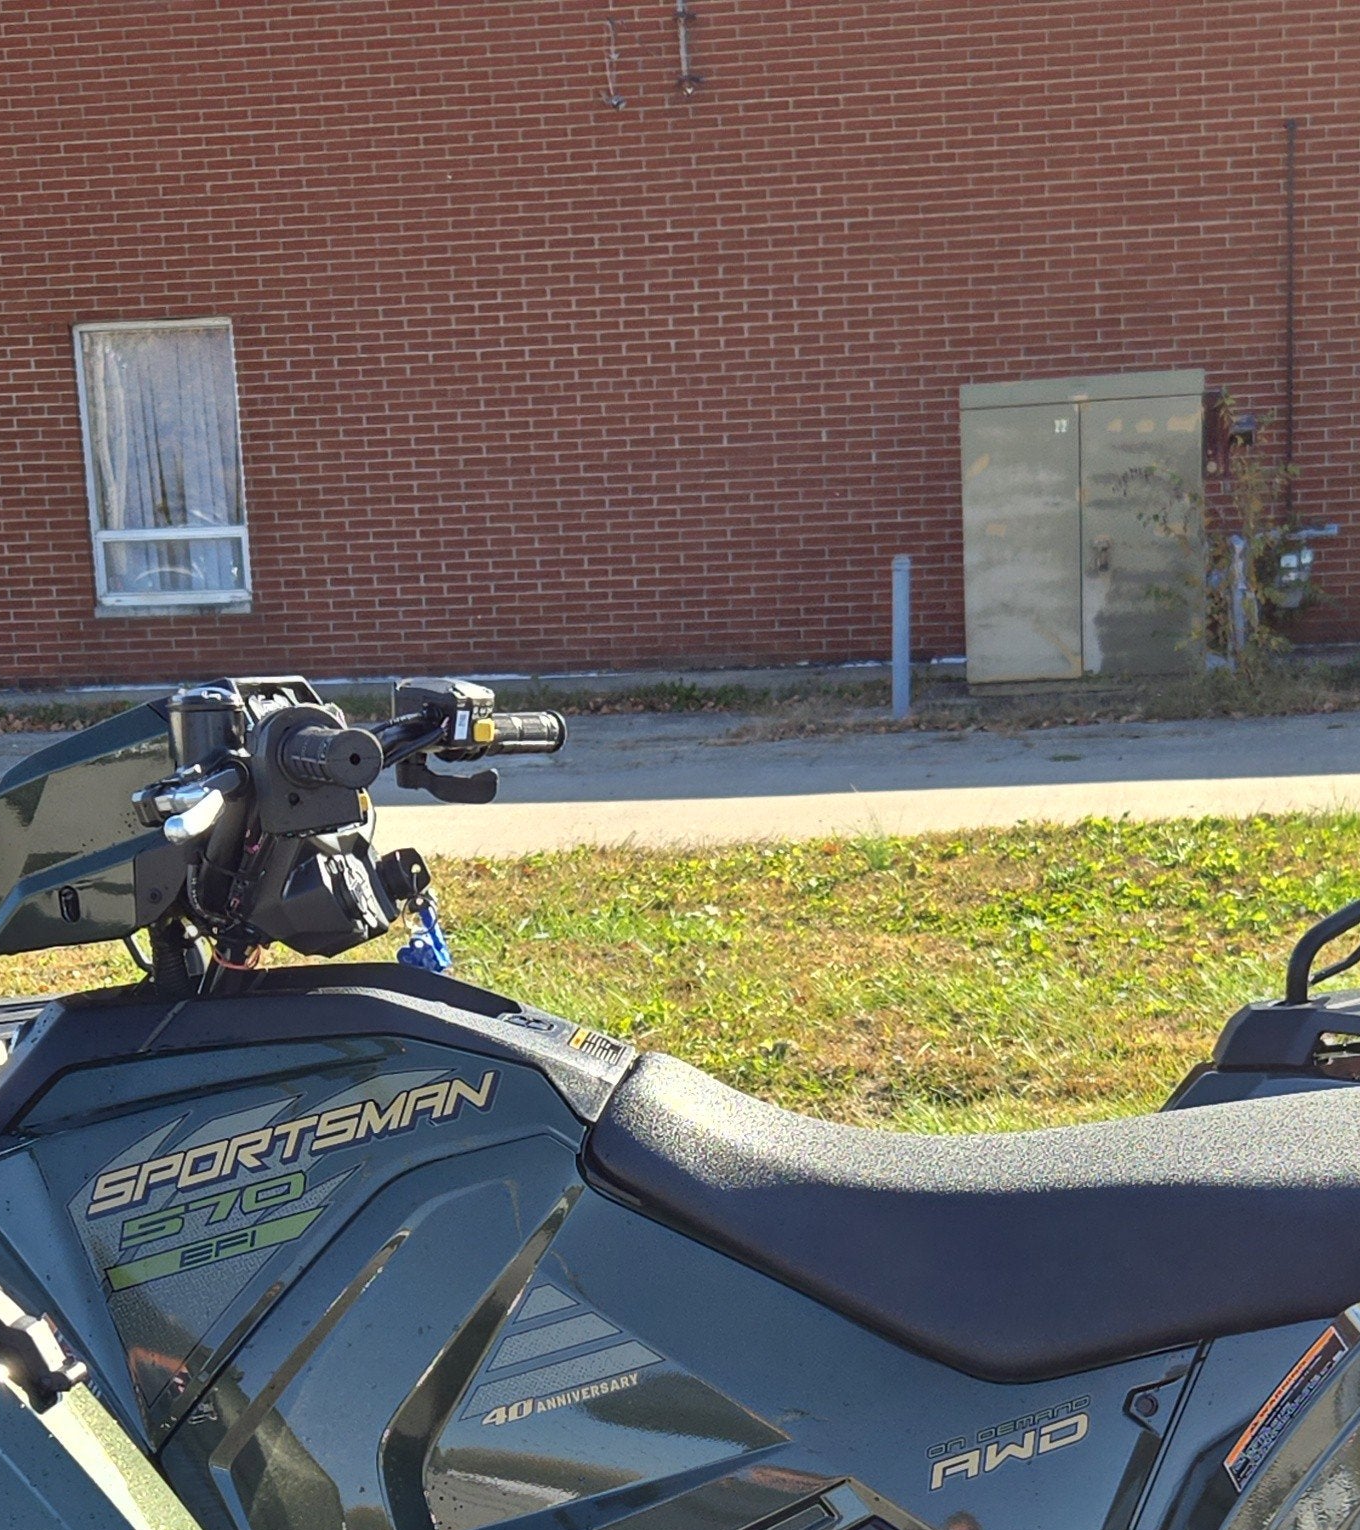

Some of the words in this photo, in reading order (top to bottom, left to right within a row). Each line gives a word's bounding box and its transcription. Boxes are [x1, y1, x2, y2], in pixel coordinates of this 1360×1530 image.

[87, 1070, 498, 1218] SPORTSMAN
[119, 1170, 308, 1251] 570
[179, 1230, 257, 1268] EFI
[482, 1397, 534, 1426] 40
[537, 1373, 639, 1413] ANNIVERSARY
[926, 1436, 967, 1459] ON
[977, 1394, 1091, 1443] DEMAND
[929, 1412, 1090, 1491] AWD
